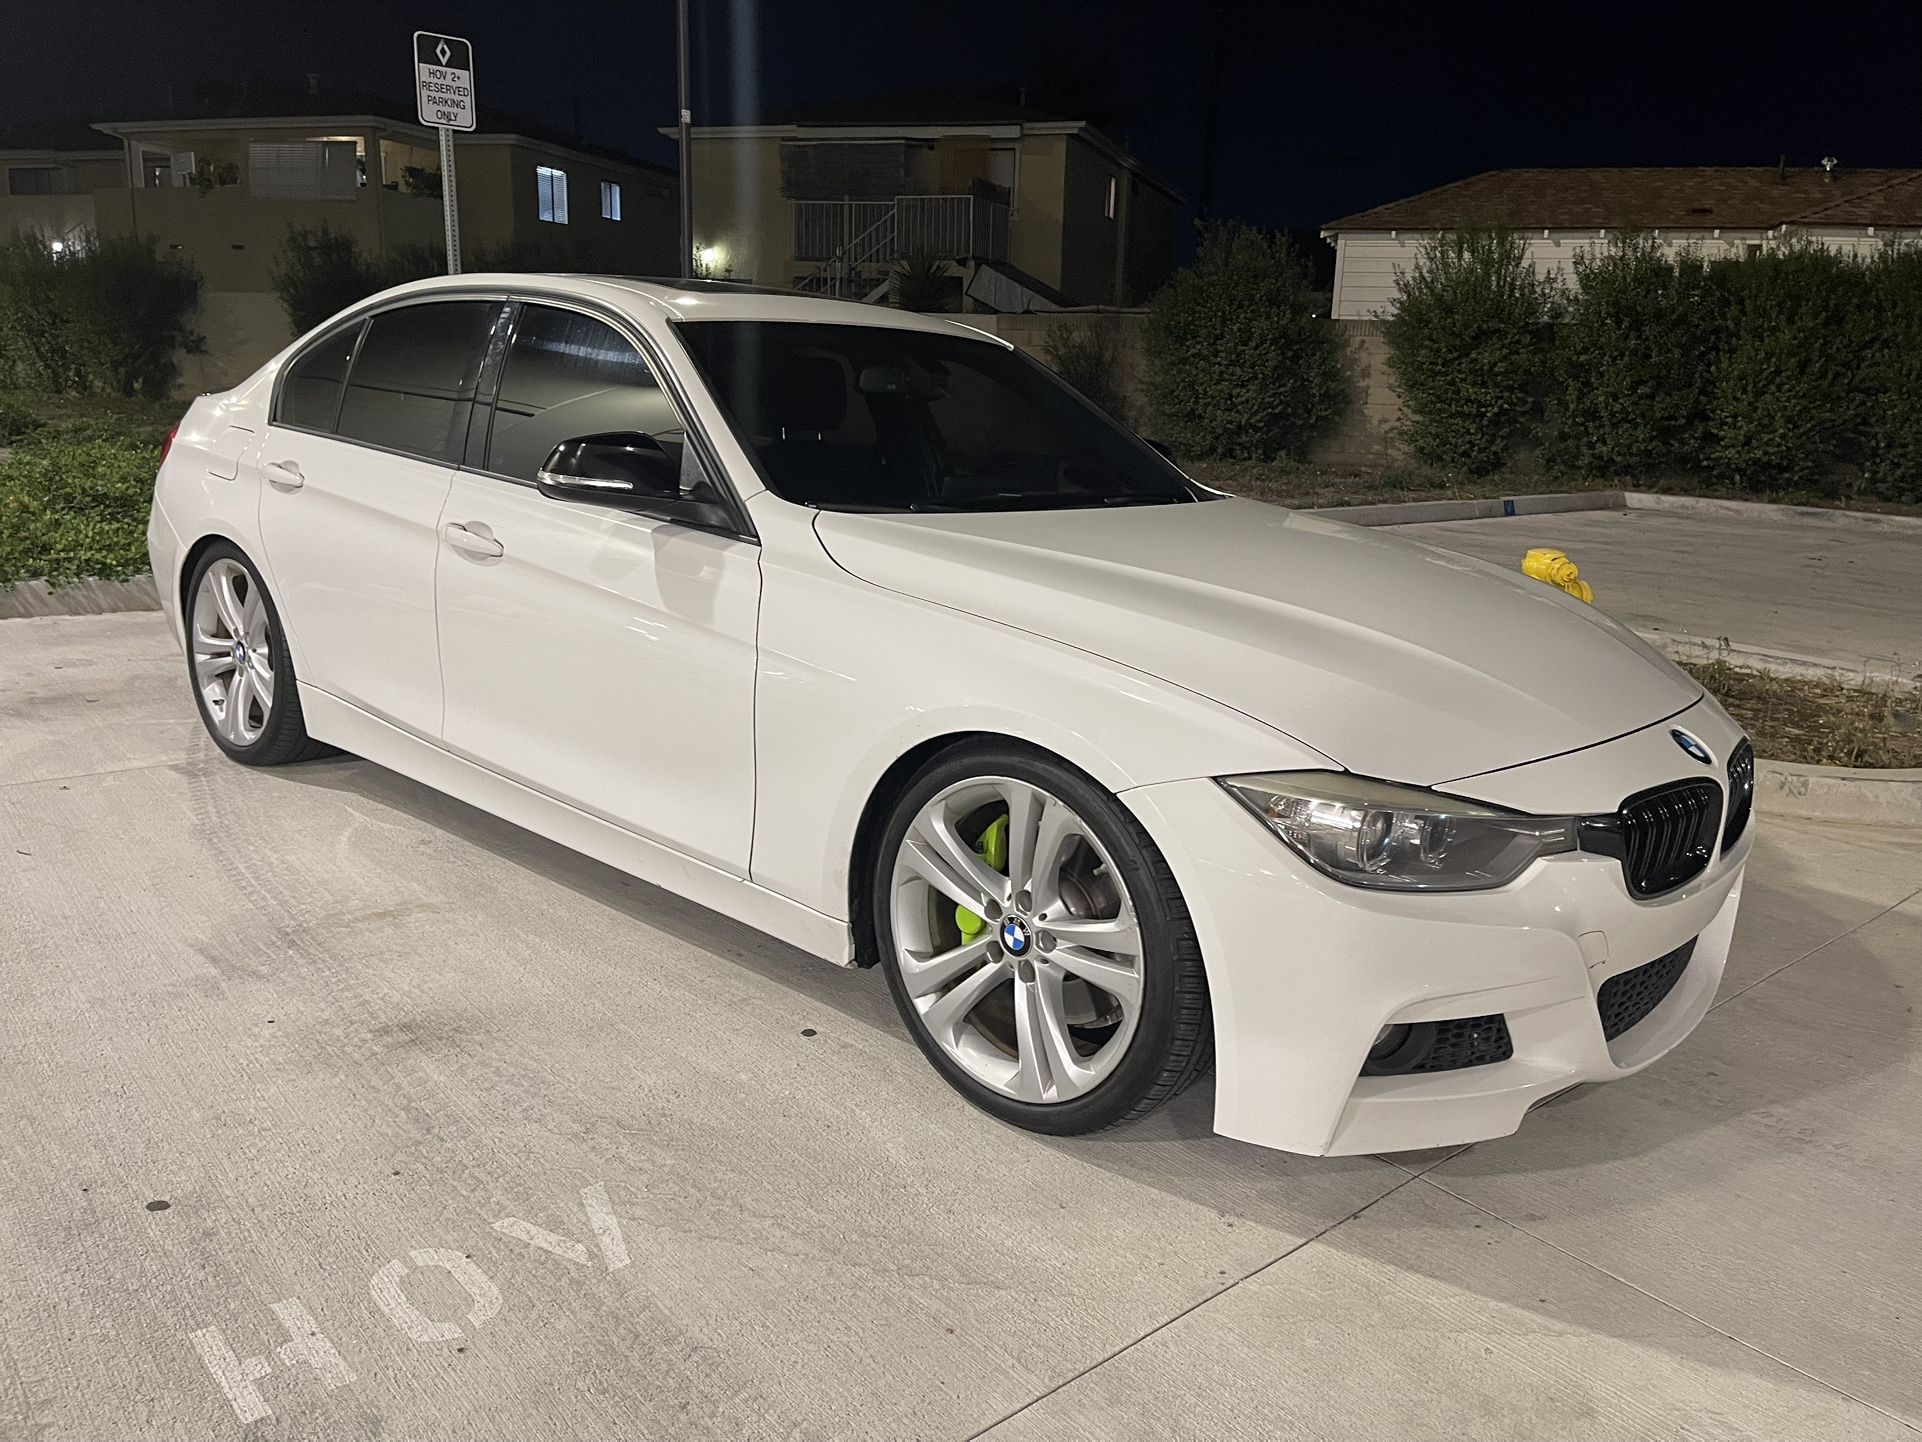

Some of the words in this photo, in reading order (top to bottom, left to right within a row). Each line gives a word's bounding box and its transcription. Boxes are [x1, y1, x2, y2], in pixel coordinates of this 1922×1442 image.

[428, 68, 447, 80] HOV
[450, 72, 461, 82] 2+
[421, 81, 470, 97] RESERVED
[427, 95, 466, 110] PARKING
[436, 109, 458, 122] ONLY
[189, 1181, 631, 1424] HOV
